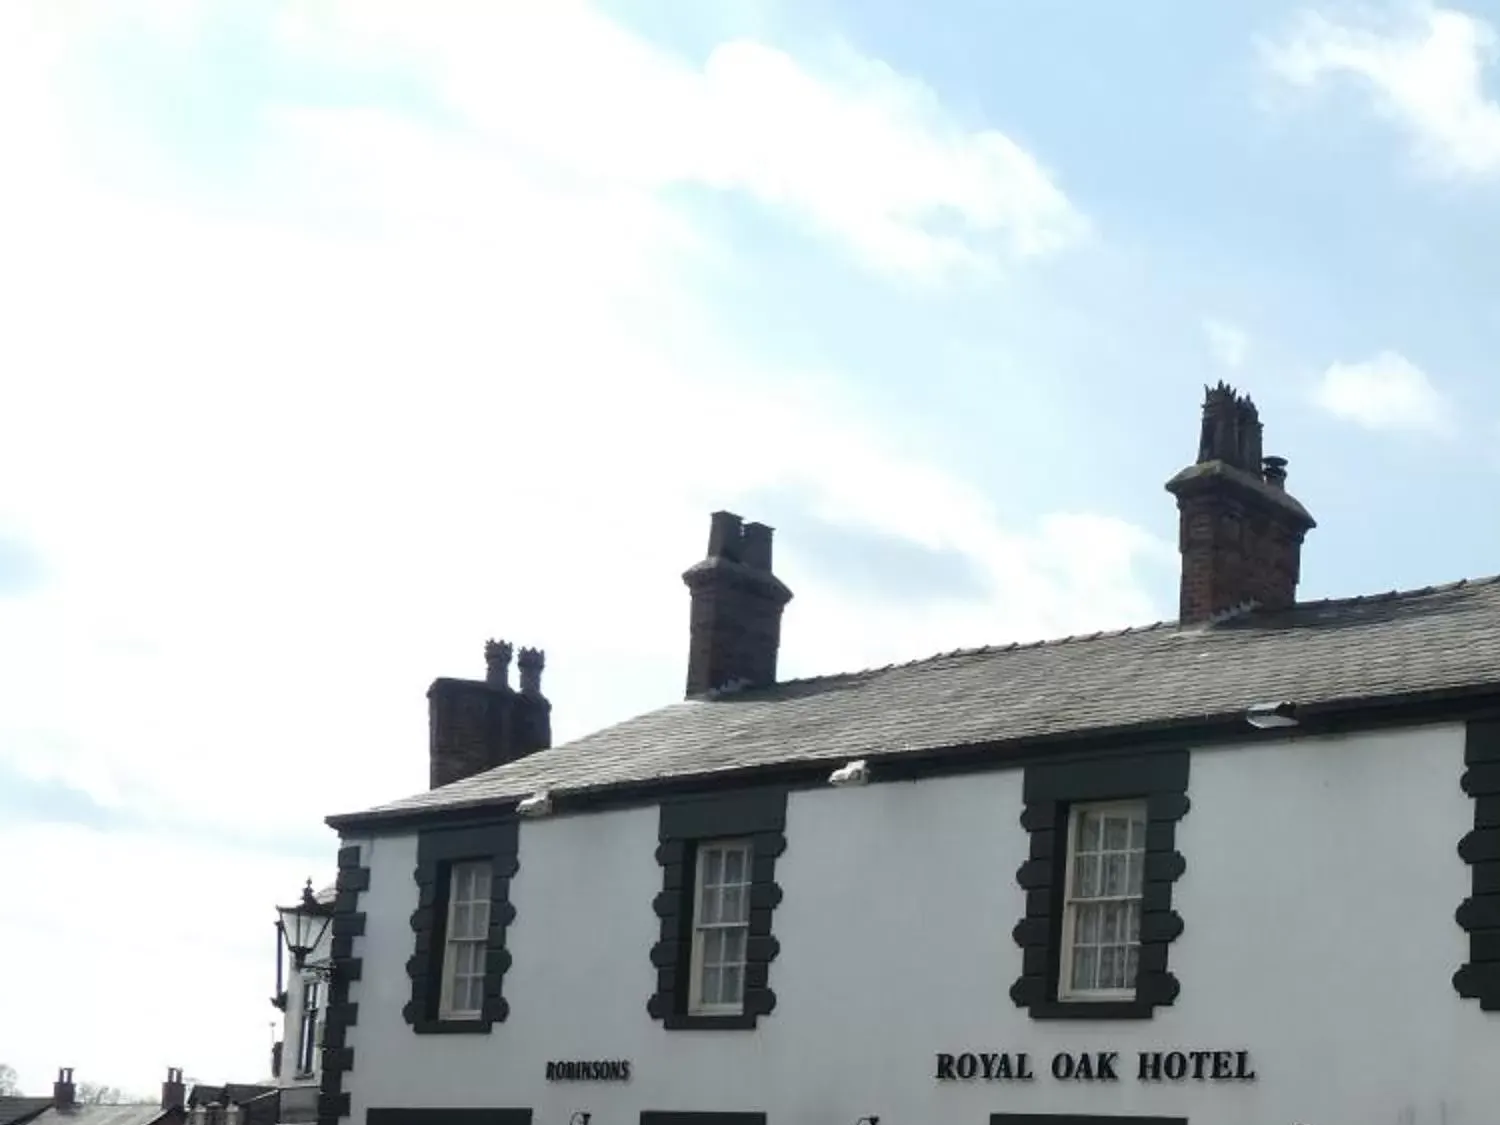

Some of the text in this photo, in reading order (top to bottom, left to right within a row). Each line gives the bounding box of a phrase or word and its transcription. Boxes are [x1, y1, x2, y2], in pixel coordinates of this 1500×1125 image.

[545, 1060, 631, 1081] ROBINSONS
[935, 1050, 1256, 1082] ROYAL OAK HOTEL
